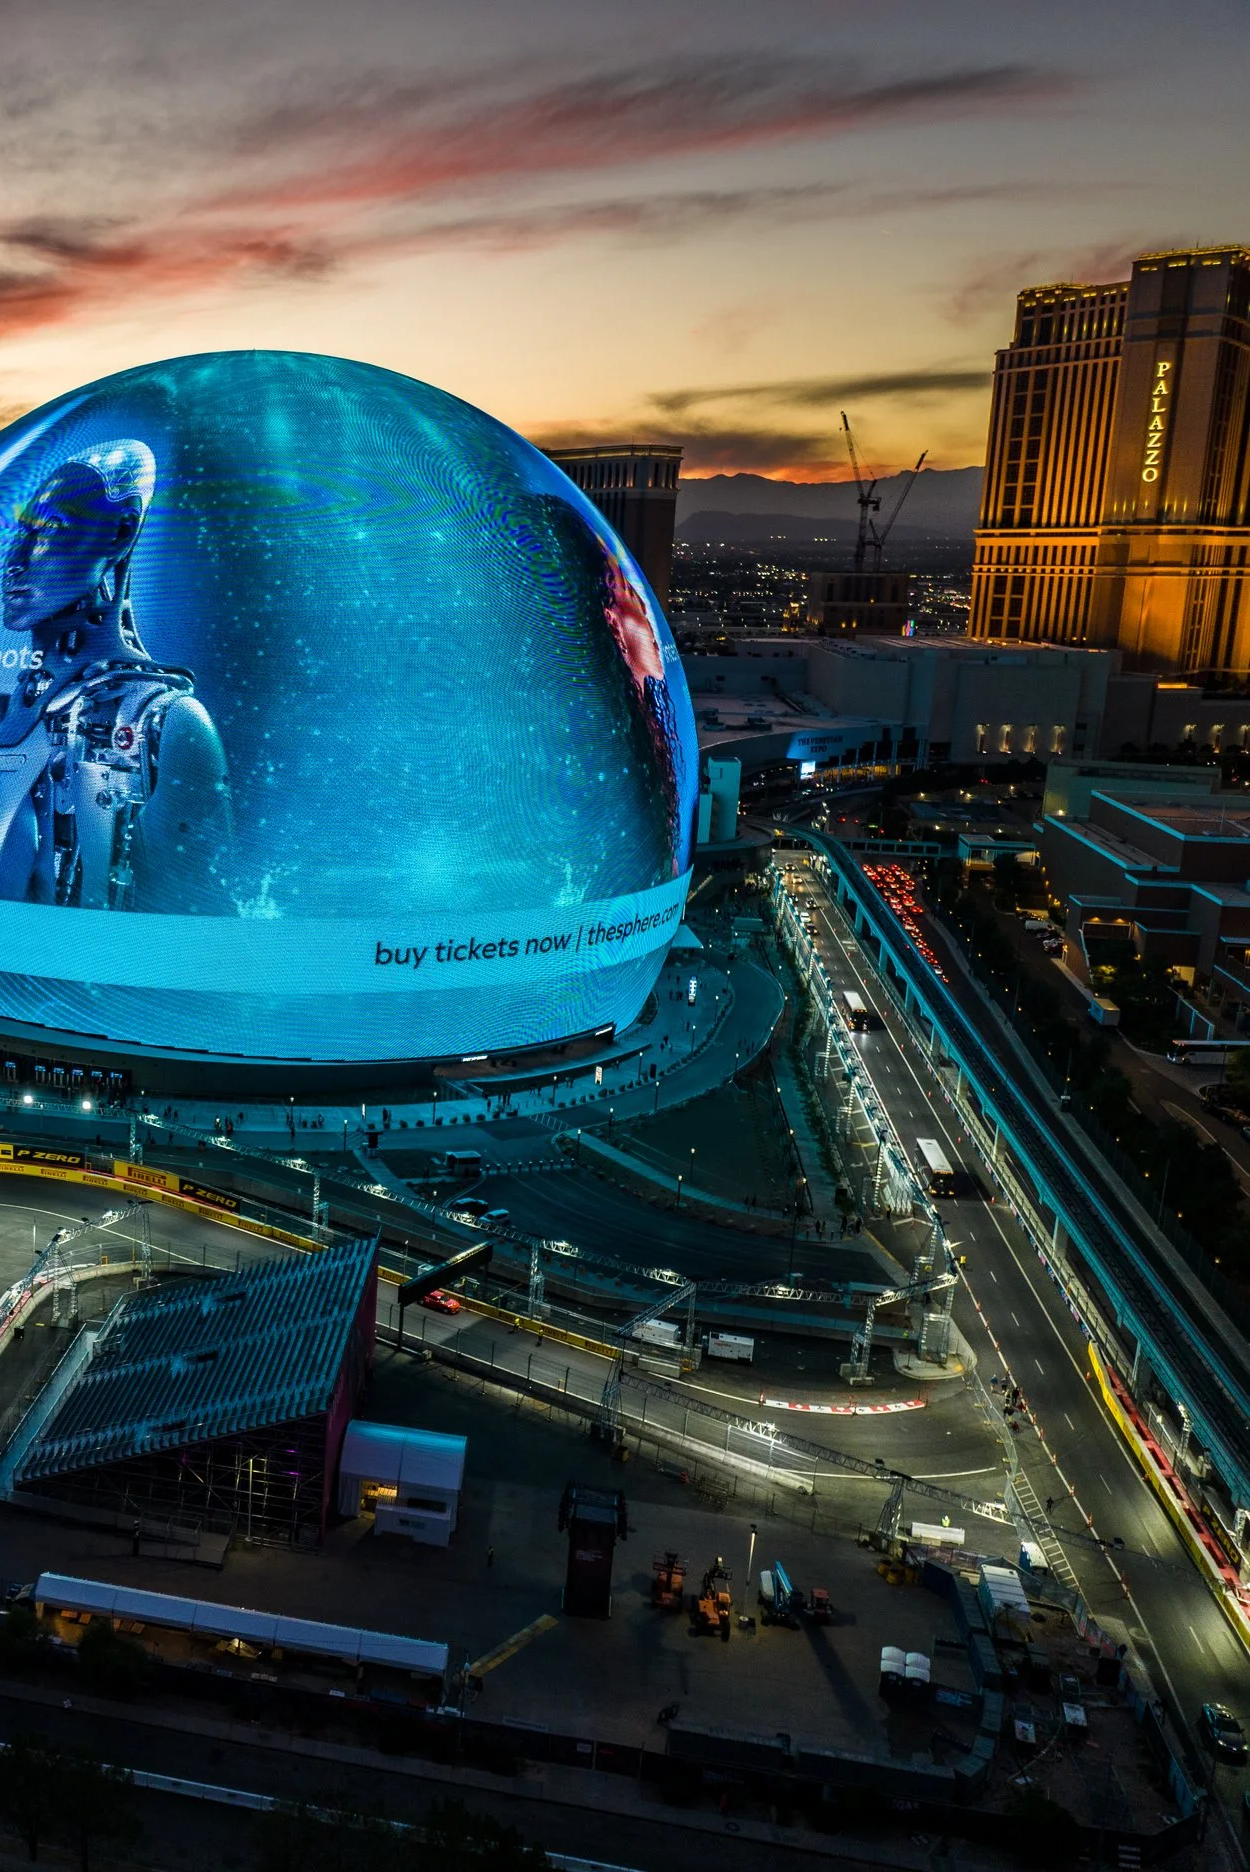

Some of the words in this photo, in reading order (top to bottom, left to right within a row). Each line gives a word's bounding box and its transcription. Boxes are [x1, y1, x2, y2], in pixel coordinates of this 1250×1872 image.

[1141, 361, 1171, 482] PALAZZO
[374, 941, 429, 970] buy
[434, 937, 519, 964] tickets
[524, 932, 572, 955] now
[586, 902, 681, 946] thesphere.com
[17, 1149, 30, 1157] P
[30, 1150, 82, 1165] ZERO
[127, 1166, 167, 1187] PIRELLI
[182, 1183, 194, 1192] P
[195, 1188, 238, 1209] ZERO
